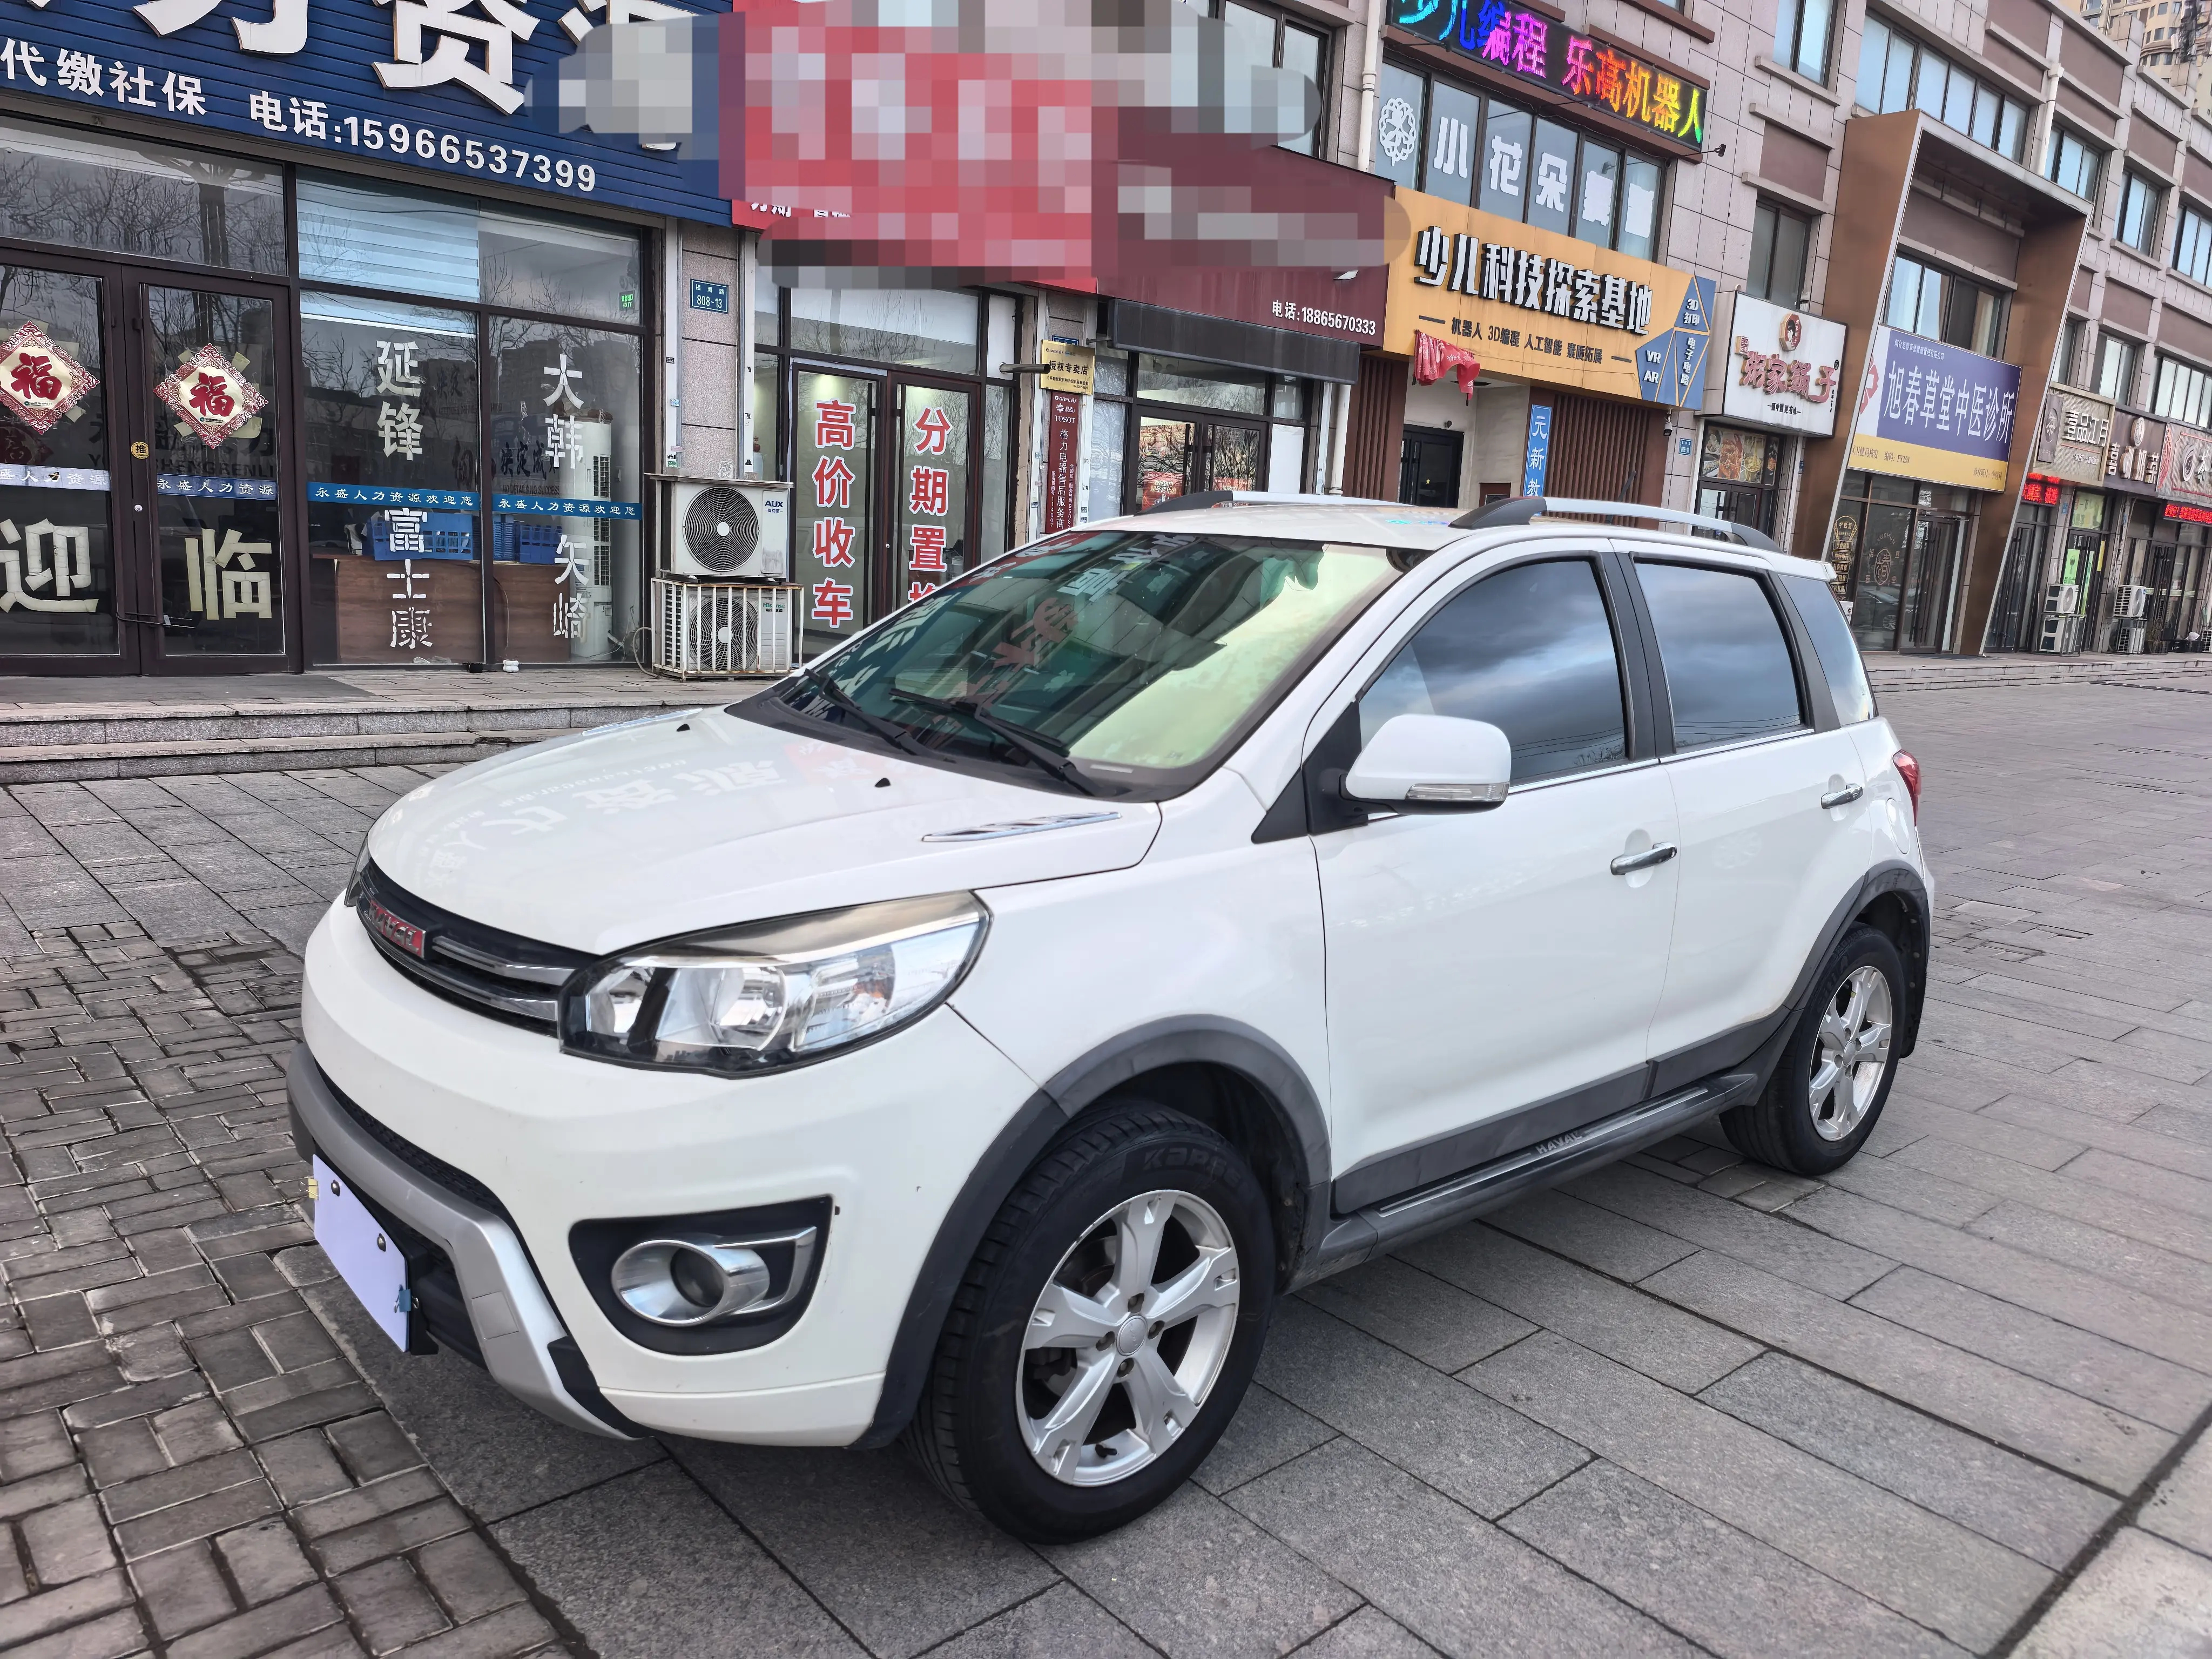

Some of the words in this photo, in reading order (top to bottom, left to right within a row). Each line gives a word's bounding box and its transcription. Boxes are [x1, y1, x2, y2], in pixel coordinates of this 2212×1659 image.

[1562, 35, 1703, 143] 乐高机器人
[0, 38, 207, 115] 代缴社保
[249, 91, 595, 192] 电话:15966537399
[697, 295, 722, 308] 808-13
[1414, 225, 1653, 335] 少儿科技探索基地
[1272, 300, 1376, 335] 电话:18865670333
[1684, 312, 1700, 326] 打印
[1686, 298, 1699, 311] 3D
[1452, 317, 1483, 340] 机器人
[1488, 325, 1520, 347] 3D编程
[1525, 334, 1562, 356] 人工智能
[1567, 343, 1603, 364] 素质拓展
[1646, 350, 1661, 364] VR
[1680, 337, 1696, 386] 电子电路
[11, 353, 62, 400] 福
[1049, 360, 1088, 375] 授权专卖店
[1644, 370, 1659, 383] AR
[189, 372, 235, 416] 福
[376, 340, 423, 461] 延锋
[543, 354, 584, 469] 大韩
[1884, 360, 2014, 444] 旭春草堂中医诊所
[1054, 415, 1076, 423] TOSOT
[1056, 429, 1068, 529] 格力电器售后服务商
[1527, 416, 1547, 496] 元新教
[157, 479, 274, 496] 永盛人力资源
[315, 487, 474, 507] 永盛人力资源欢迎您
[498, 498, 636, 516] 永盛人力资源欢迎您
[812, 399, 855, 627] 高价收车
[0, 518, 99, 612] 迎
[185, 528, 272, 619] 临
[384, 507, 433, 649] 富士康
[552, 534, 589, 638] 矢崎
[1535, 1132, 1582, 1155] HAVAL
